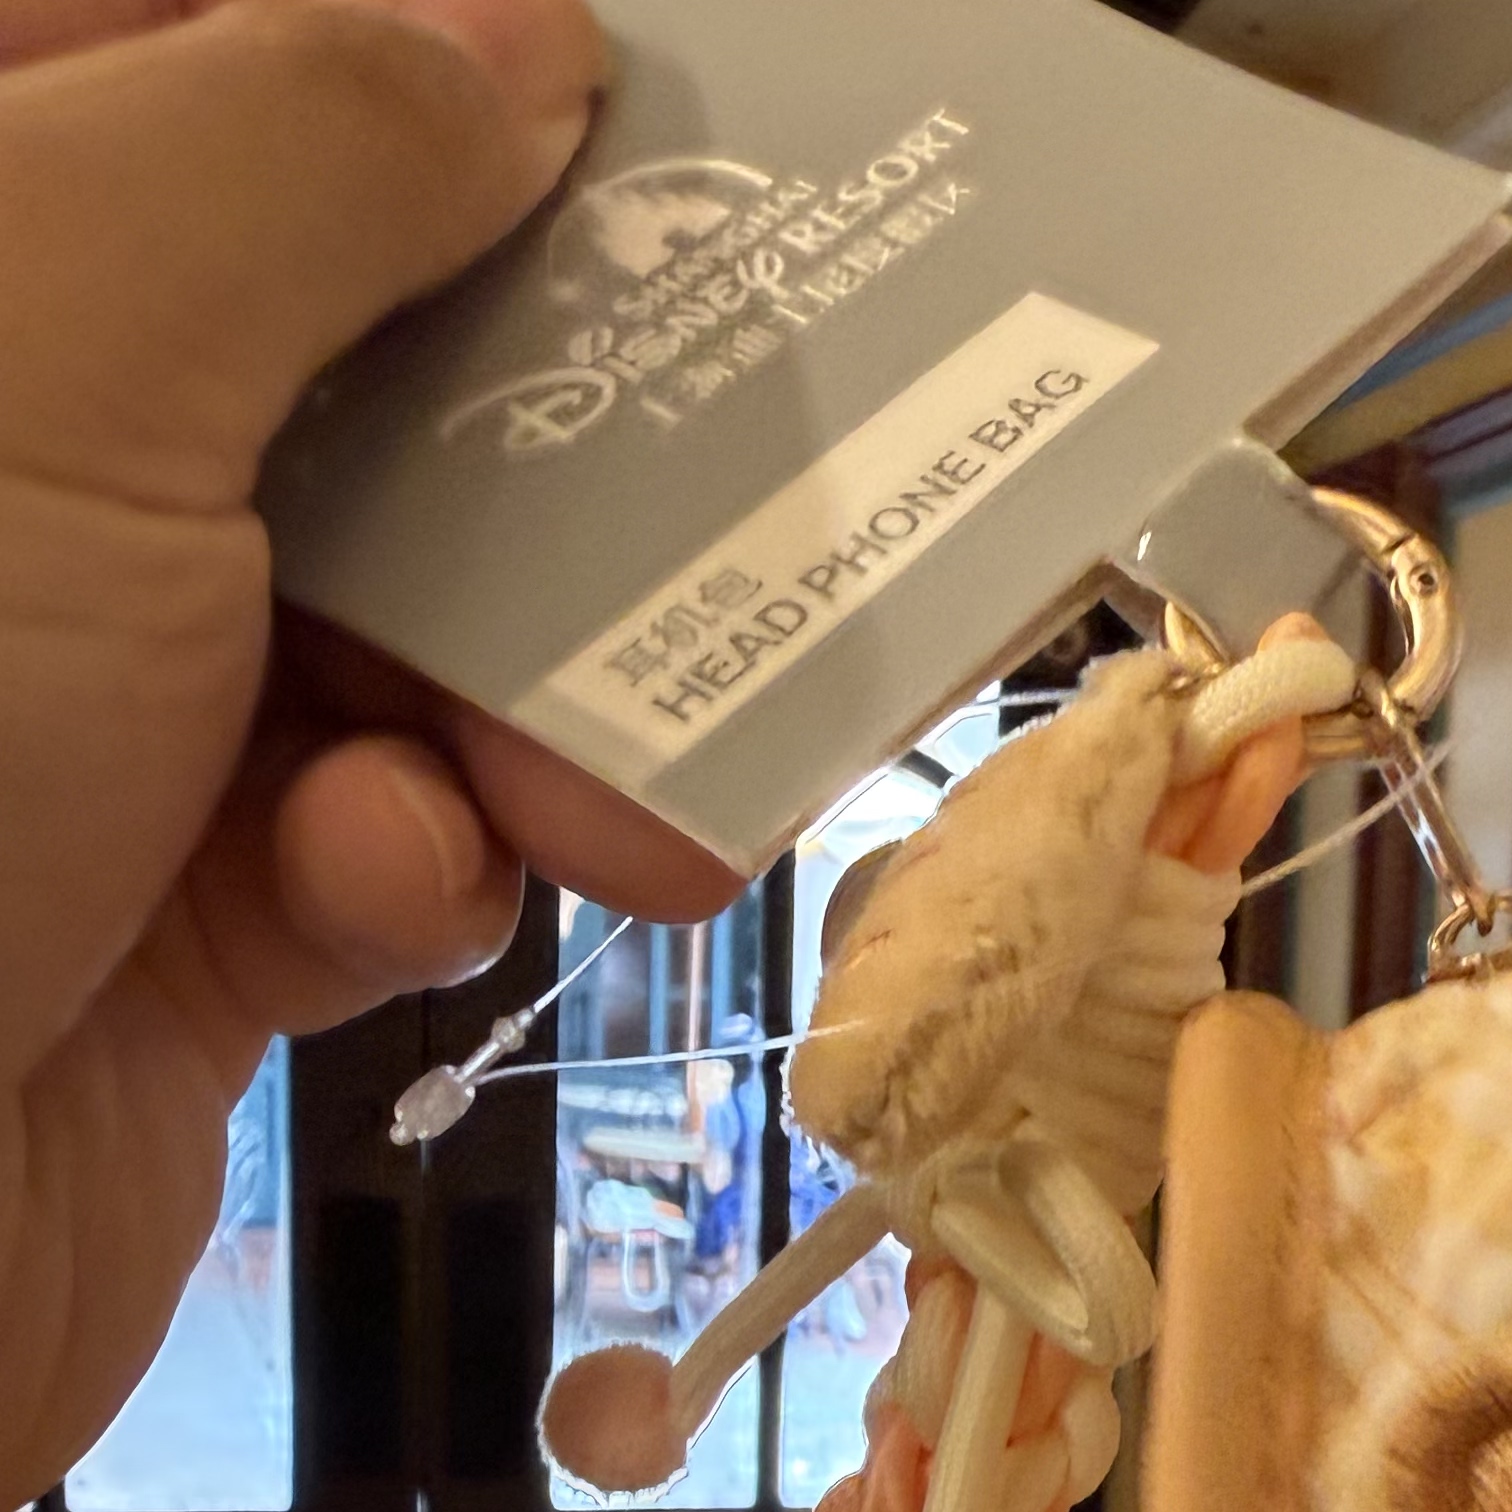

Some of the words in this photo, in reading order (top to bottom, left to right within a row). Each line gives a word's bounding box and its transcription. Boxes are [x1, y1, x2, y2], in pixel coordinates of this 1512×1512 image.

[779, 108, 969, 256] RESORT
[652, 599, 808, 722] HEAD
[799, 450, 987, 602] PHONE
[968, 367, 1089, 454] BAG
